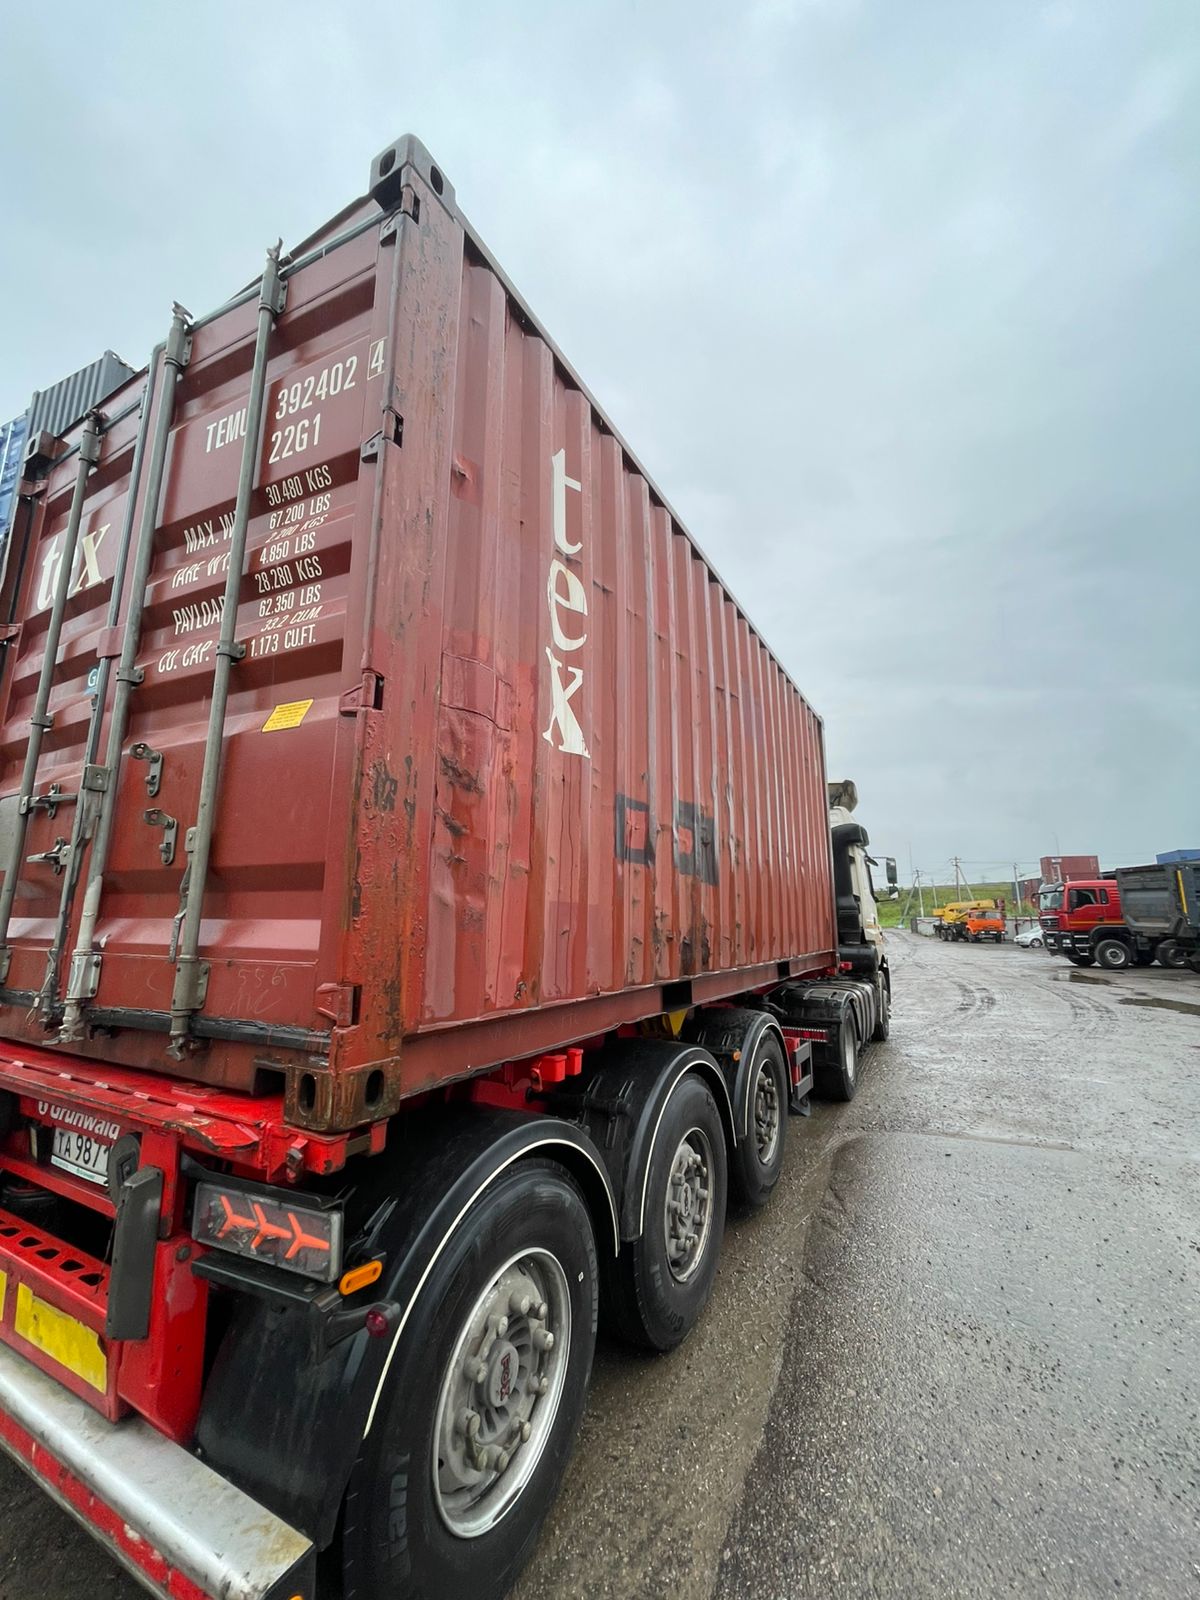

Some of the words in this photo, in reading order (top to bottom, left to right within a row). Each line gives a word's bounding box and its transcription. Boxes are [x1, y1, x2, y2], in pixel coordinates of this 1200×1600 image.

[206, 408, 247, 453] TEMU
[275, 355, 358, 420] 392402
[371, 340, 385, 373] 4
[268, 412, 321, 464] 22G1
[184, 520, 219, 554] MAX.
[219, 509, 236, 539] W
[265, 475, 303, 506] 30.480
[306, 465, 332, 488] KGS
[269, 502, 304, 530] 67.200
[309, 493, 331, 516] LBS
[171, 561, 206, 589] TARE
[300, 514, 329, 532] KGS
[255, 564, 293, 594] 28.280
[295, 555, 323, 582] KGS
[259, 541, 289, 565] 4.850
[294, 532, 316, 555] LBS
[258, 591, 294, 617] 62.350
[300, 584, 322, 607] LBS
[542, 447, 591, 759] tex
[158, 649, 178, 673] CU.
[182, 640, 213, 667] CAP.
[260, 614, 290, 632] 33.2
[250, 633, 279, 658] 1.173
